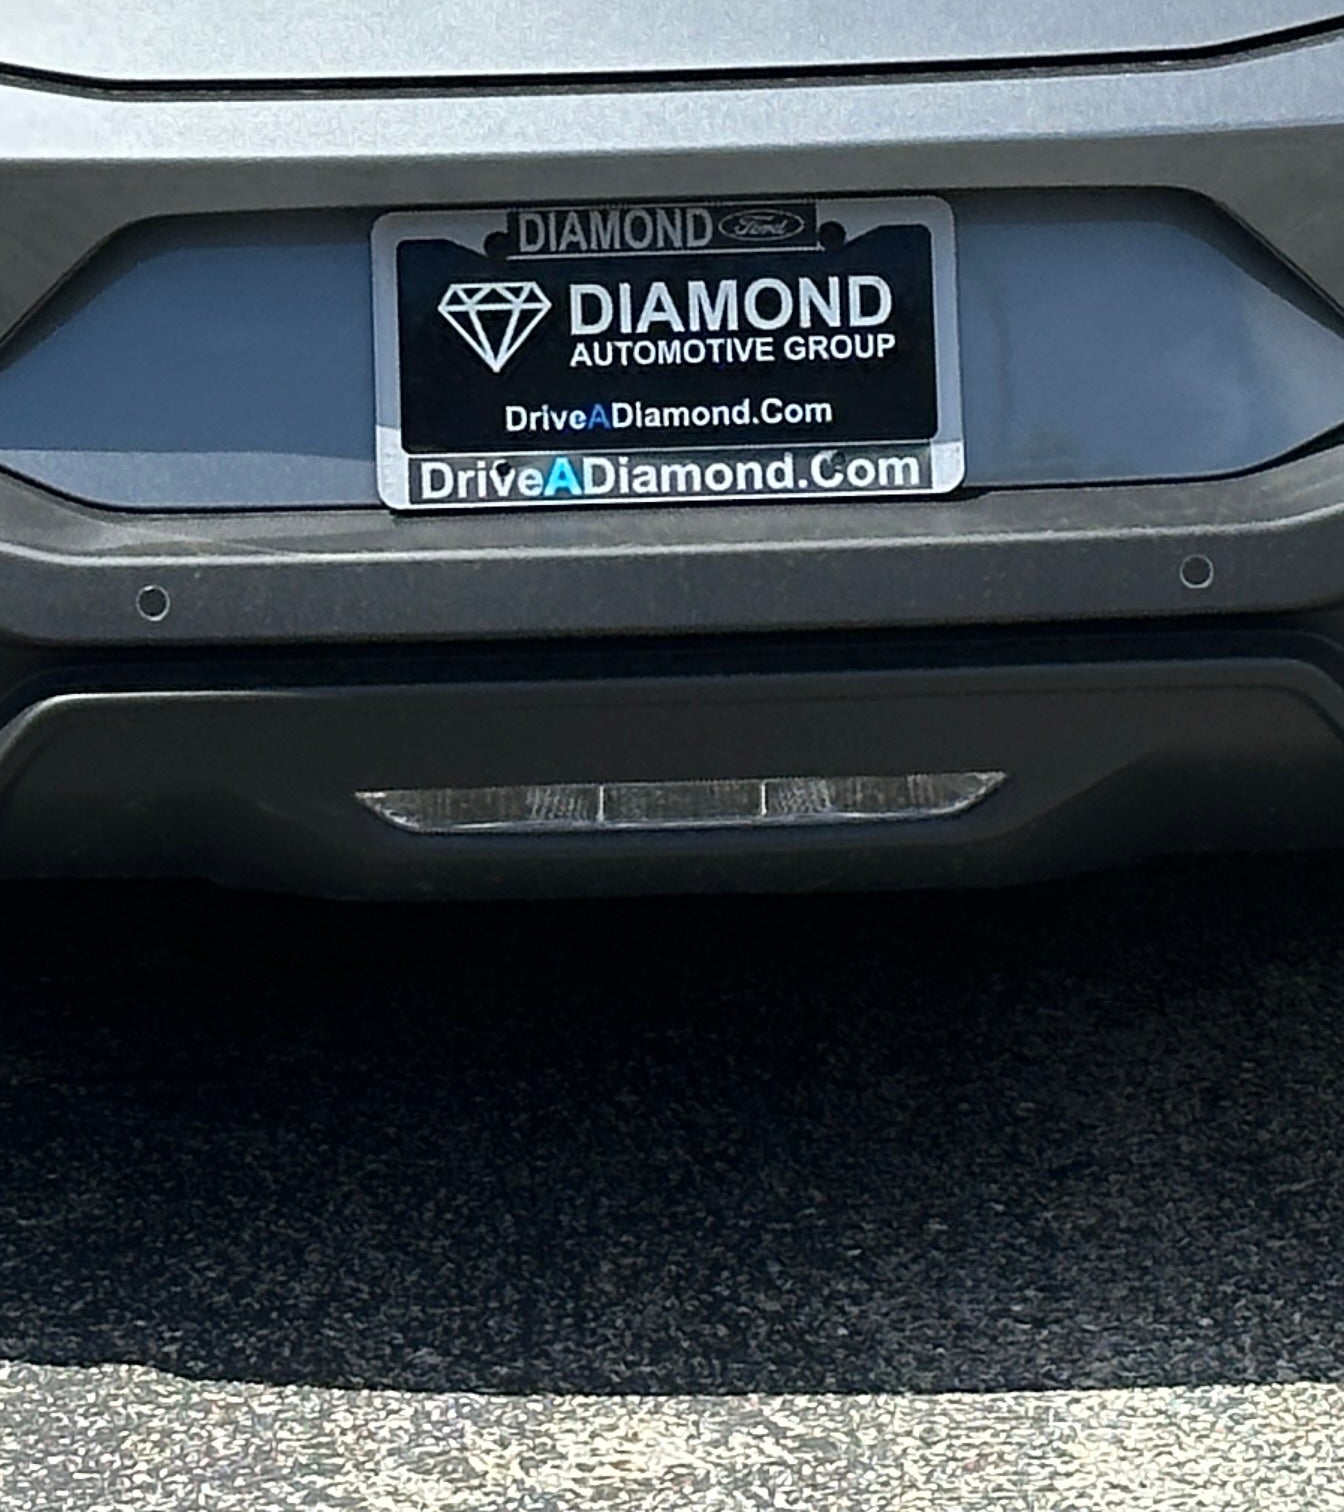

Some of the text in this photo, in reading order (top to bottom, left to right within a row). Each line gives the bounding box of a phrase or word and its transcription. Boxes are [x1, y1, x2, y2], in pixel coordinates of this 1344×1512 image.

[517, 207, 789, 253] DIAMOND Ford
[569, 274, 892, 336] DIAMOND
[569, 333, 897, 367] AUTOMOTIVE GROUP
[505, 396, 833, 432] DriveADiamond.Com
[420, 449, 920, 500] DriveADiamond.Com
